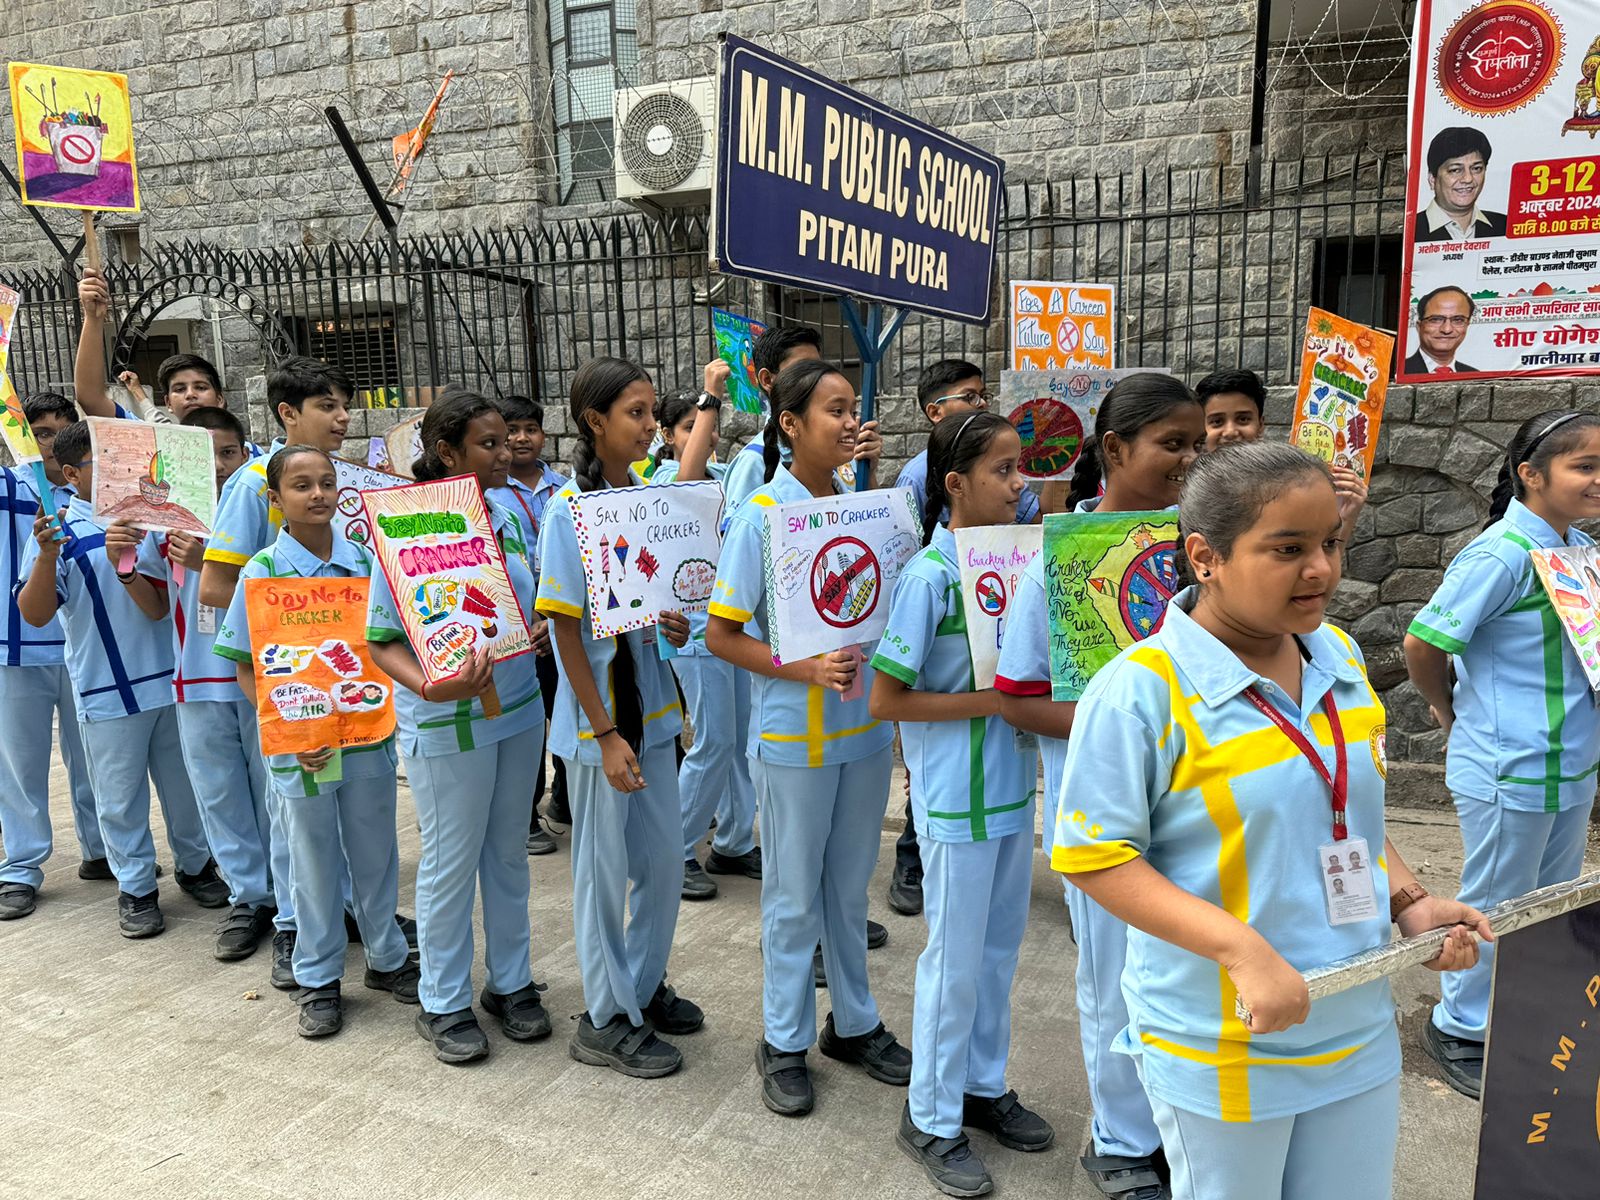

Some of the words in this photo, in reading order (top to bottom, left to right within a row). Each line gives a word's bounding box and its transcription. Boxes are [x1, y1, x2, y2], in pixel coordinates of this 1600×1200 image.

[1470, 51, 1532, 80] रामलीला
[1480, 91, 1496, 99] 2024
[738, 69, 812, 185] M.M.
[822, 105, 911, 218] PUBLIC
[916, 146, 992, 244] SCHOOL
[1530, 161, 1596, 196] 3-12
[1519, 198, 1565, 218] अक्टूबर
[1566, 195, 1600, 211] 2024
[1513, 219, 1536, 236] रात्रि
[1539, 220, 1567, 234] 8.00
[1570, 215, 1590, 231] बजे
[798, 209, 882, 275] PITAM
[889, 237, 948, 291] PURA
[1418, 242, 1440, 254] अशोक
[1442, 241, 1462, 253] गोयल
[1442, 252, 1464, 262] अध्यक्ष
[1552, 248, 1575, 260] नेताजी
[1576, 249, 1597, 259] सुभाष
[1504, 263, 1533, 275] हल्दीराम
[1534, 262, 1542, 273] के
[1543, 261, 1565, 272] सामने
[1566, 260, 1597, 272] पीतमपुरा
[1049, 289, 1063, 314] A
[1068, 289, 1105, 315] Green
[1481, 306, 1502, 318] आप
[1505, 302, 1530, 316] सभी
[1532, 301, 1580, 316] सपरिवार
[1017, 317, 1051, 347] Future
[1084, 322, 1107, 357] Say
[1493, 327, 1538, 347] सीए
[1307, 335, 1330, 357] Say
[1335, 336, 1355, 358] No
[1363, 357, 1378, 379] to
[1521, 351, 1586, 365] शालीमार
[1049, 378, 1068, 397] Say
[1092, 378, 1101, 391] to
[1314, 362, 1367, 401] CRACKER
[364, 475, 383, 488] Clean
[594, 507, 619, 526] SAY
[629, 502, 647, 522] NO
[653, 498, 669, 517] TO
[788, 515, 807, 532] SAY
[809, 512, 823, 529] NO
[826, 511, 838, 525] TO
[841, 507, 890, 525] CRACKERS
[378, 512, 417, 538] Say
[647, 520, 701, 543] CRACKERS
[399, 537, 491, 577] CRACKER
[825, 580, 842, 603] SAY
[845, 569, 857, 586] NO
[265, 586, 308, 612] Say
[311, 586, 336, 604] No
[340, 586, 363, 602] to
[279, 610, 343, 626] CRACKER
[1072, 619, 1097, 631] use
[1083, 633, 1105, 648] are
[1060, 656, 1087, 674] just
[275, 688, 287, 698] BE
[300, 703, 326, 718] AIR
[1262, 706, 1284, 727] SCHOOL
